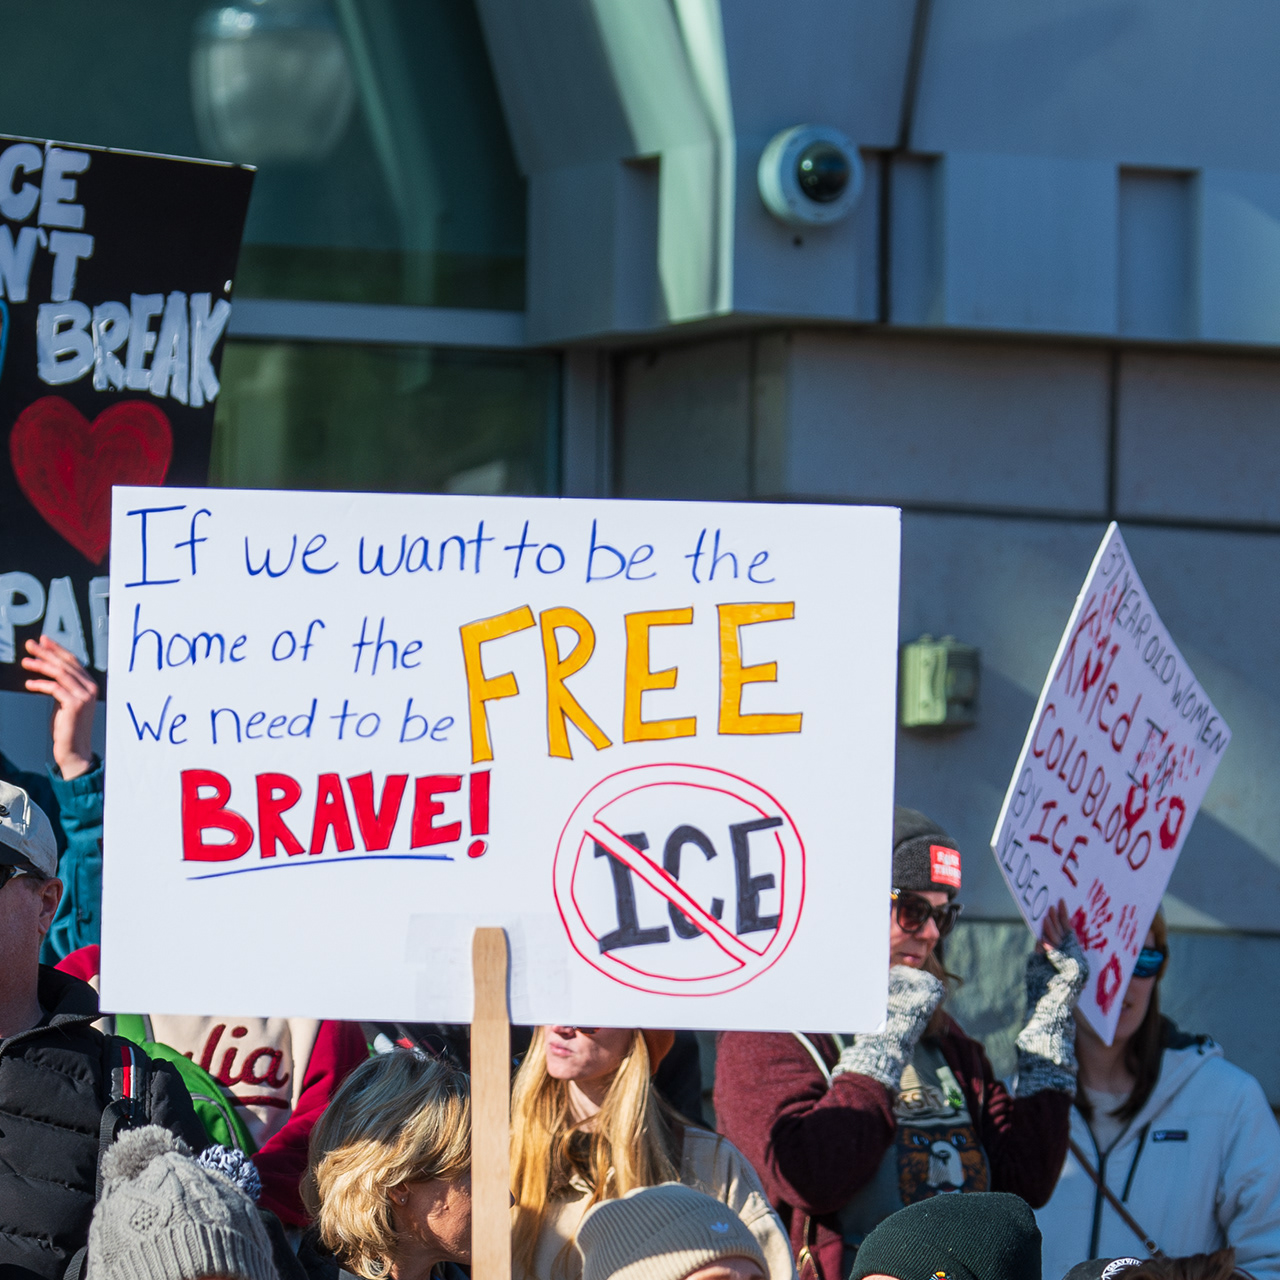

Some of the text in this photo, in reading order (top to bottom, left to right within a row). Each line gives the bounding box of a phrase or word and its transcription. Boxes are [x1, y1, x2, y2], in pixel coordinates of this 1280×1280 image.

[37, 291, 232, 408] BREAK
[125, 505, 775, 588] If we want to be the
[126, 695, 455, 745] We need to be
[128, 601, 803, 764] home of the FREE
[1112, 570, 1153, 650] YEAR
[1142, 635, 1177, 685] OLD
[1172, 672, 1228, 756] WOMEN
[180, 768, 492, 862] BRAVE!
[1010, 766, 1089, 888] BY ICE
[1032, 703, 1152, 871] COLD BLOOD
[593, 816, 784, 955] ICE
[184, 1023, 290, 1089] lia
